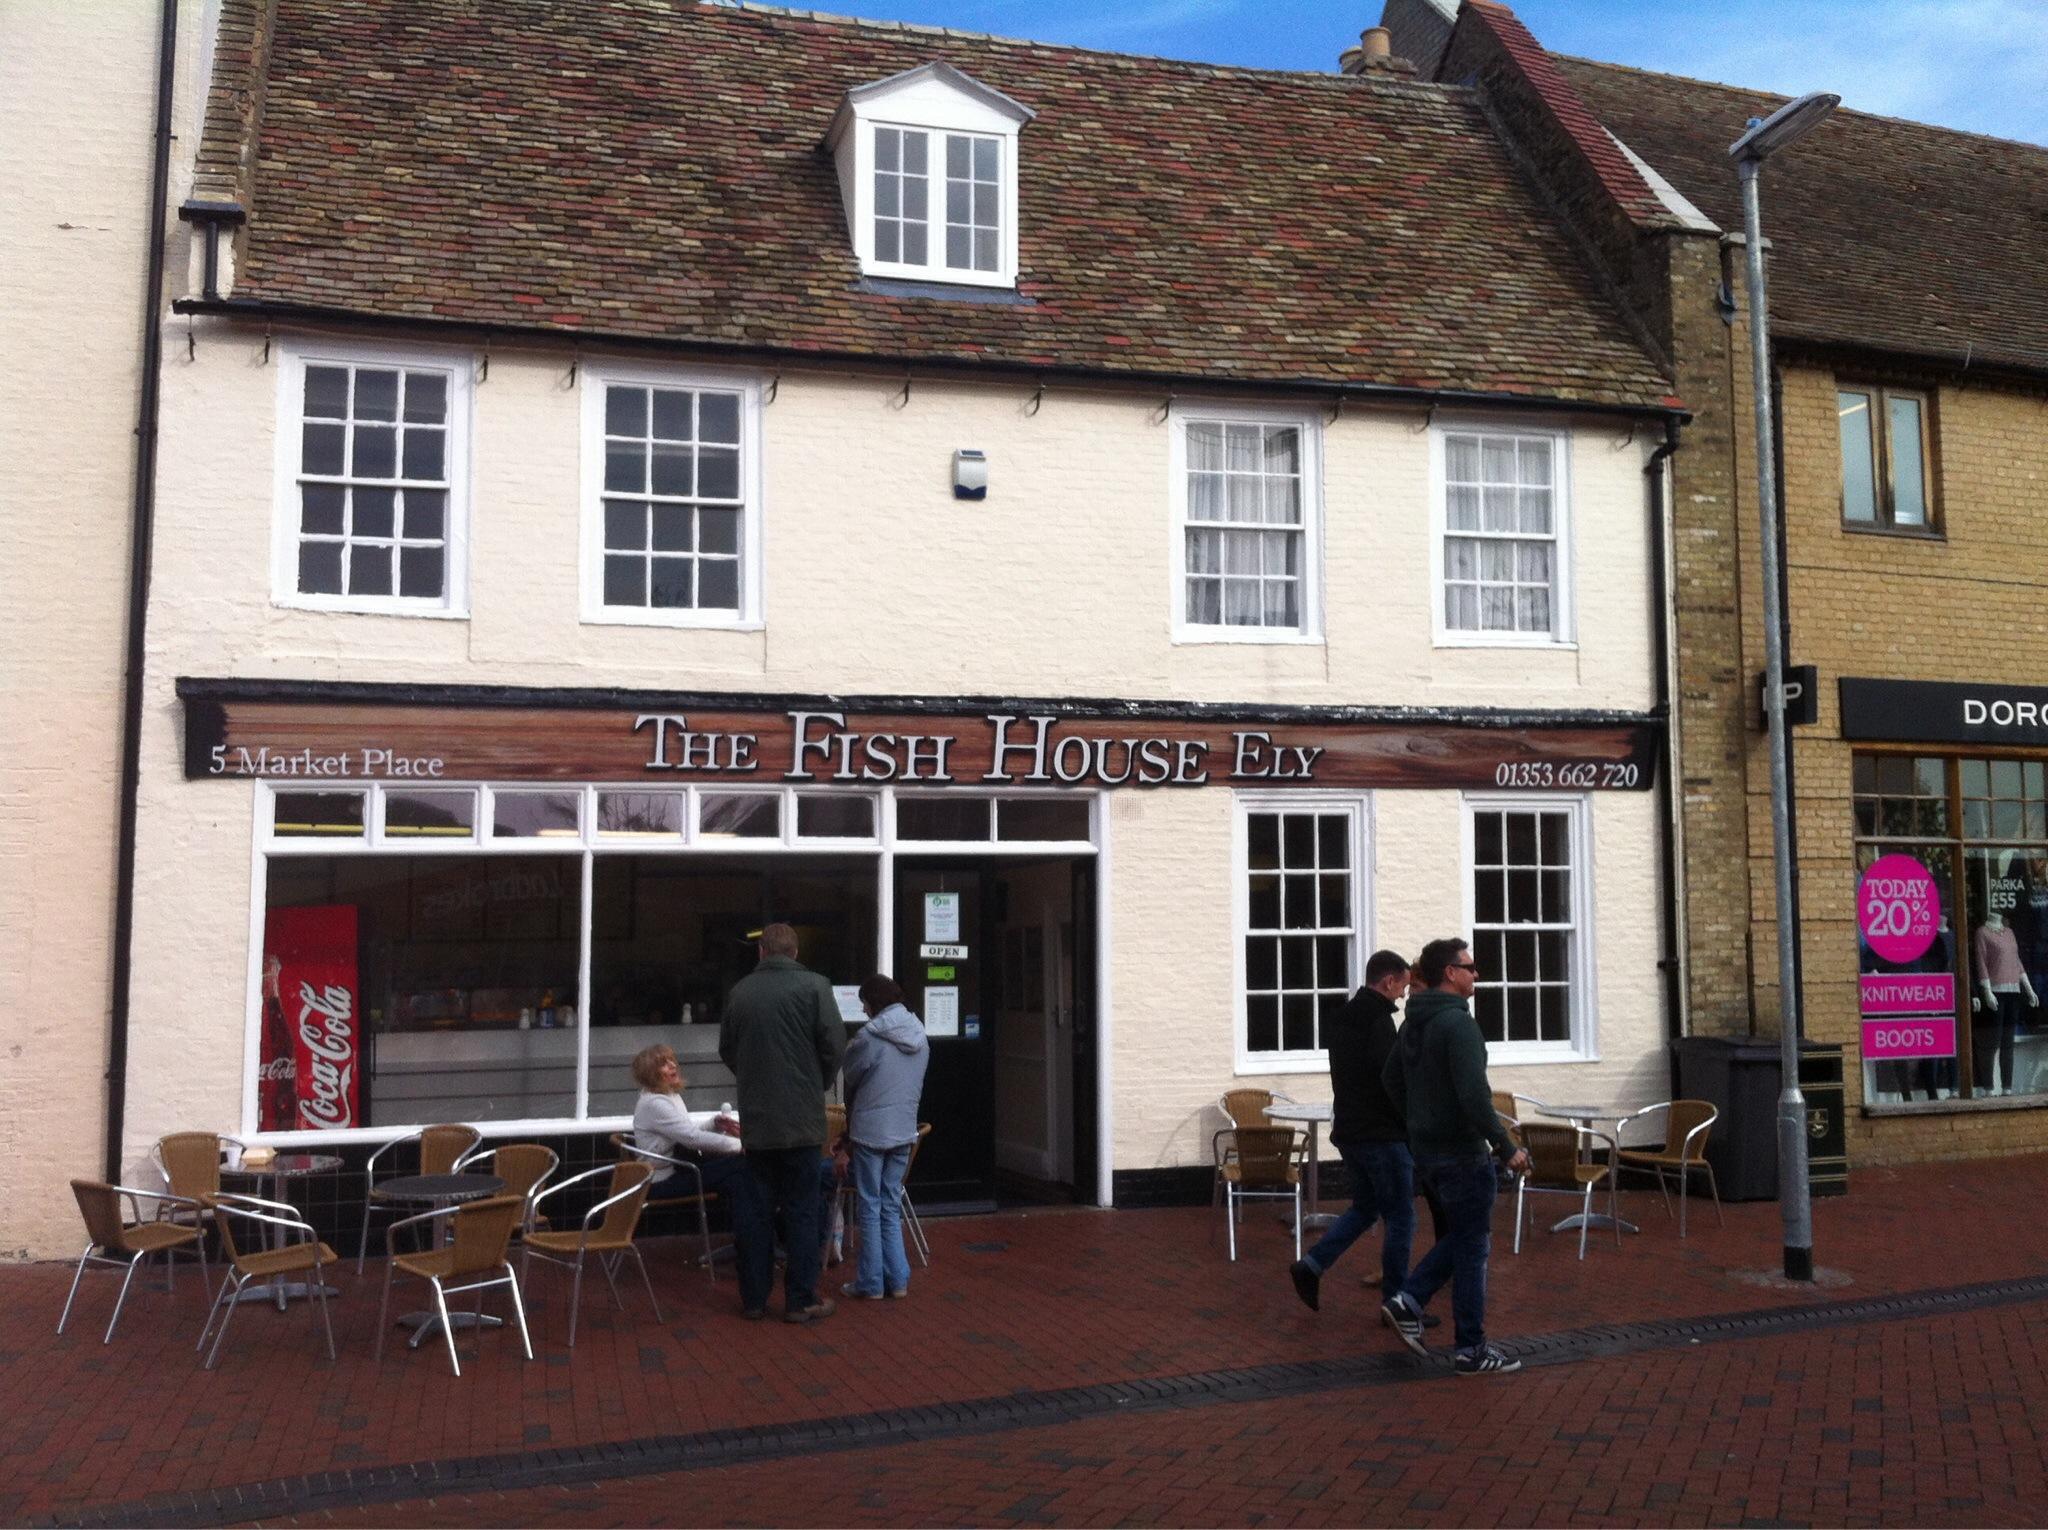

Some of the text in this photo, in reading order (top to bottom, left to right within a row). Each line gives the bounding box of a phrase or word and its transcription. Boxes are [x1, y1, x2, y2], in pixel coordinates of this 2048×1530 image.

[1763, 682, 1803, 711] P
[1964, 699, 2048, 727] DOR
[635, 711, 1325, 783] THE FISH HOUSE ELY
[209, 744, 444, 777] 5 Market Place
[1495, 762, 1639, 787] 01353 662 720
[1866, 879, 1930, 898] TODAY
[1990, 879, 2026, 890] PARKA
[1991, 892, 2017, 909] £55
[1867, 899, 1931, 936] 20%
[928, 946, 960, 957] OPEN
[1861, 984, 1947, 1002] KNITWEAR
[1875, 1028, 1935, 1048] BOOTS
